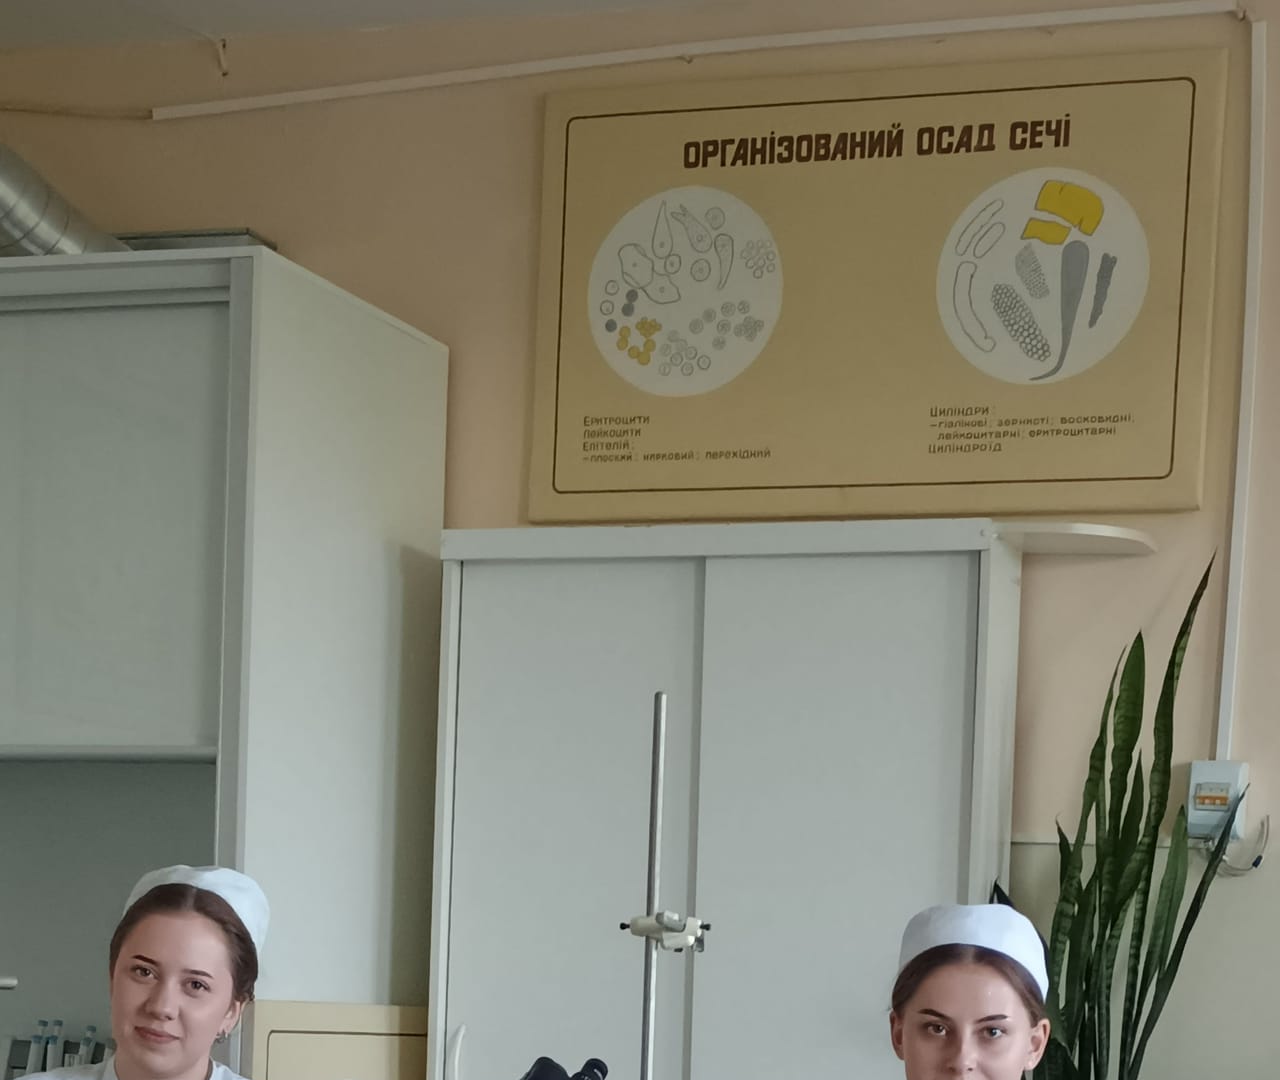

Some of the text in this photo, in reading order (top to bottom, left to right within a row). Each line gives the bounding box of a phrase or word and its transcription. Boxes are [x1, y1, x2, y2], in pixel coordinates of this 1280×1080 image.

[682, 113, 1072, 169] ОРГАНІЗОВАНИЙ ОСАД СЕЧІ
